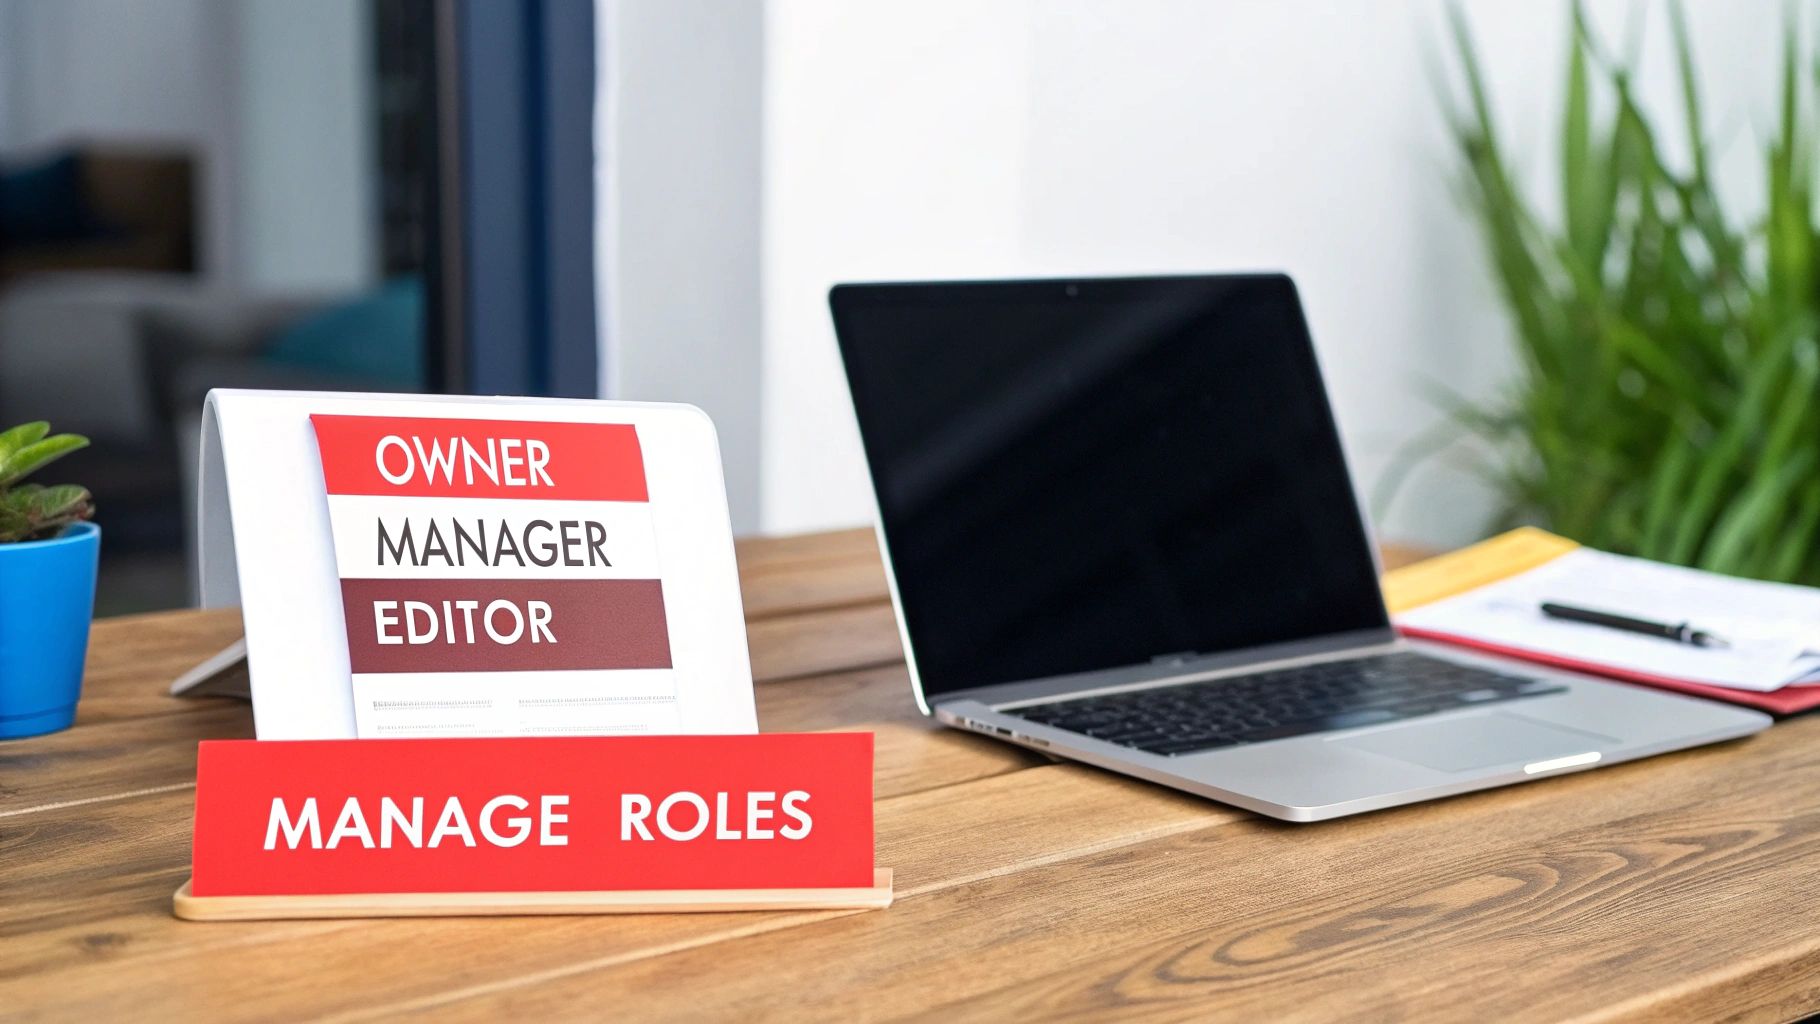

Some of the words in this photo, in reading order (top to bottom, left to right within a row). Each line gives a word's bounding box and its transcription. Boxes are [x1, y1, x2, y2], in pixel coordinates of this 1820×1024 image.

[375, 434, 555, 487] OWNER
[377, 516, 612, 568] MANAGER
[373, 599, 558, 645] EDITOR
[263, 793, 570, 851] MANAGE
[620, 790, 813, 842] ROLES
